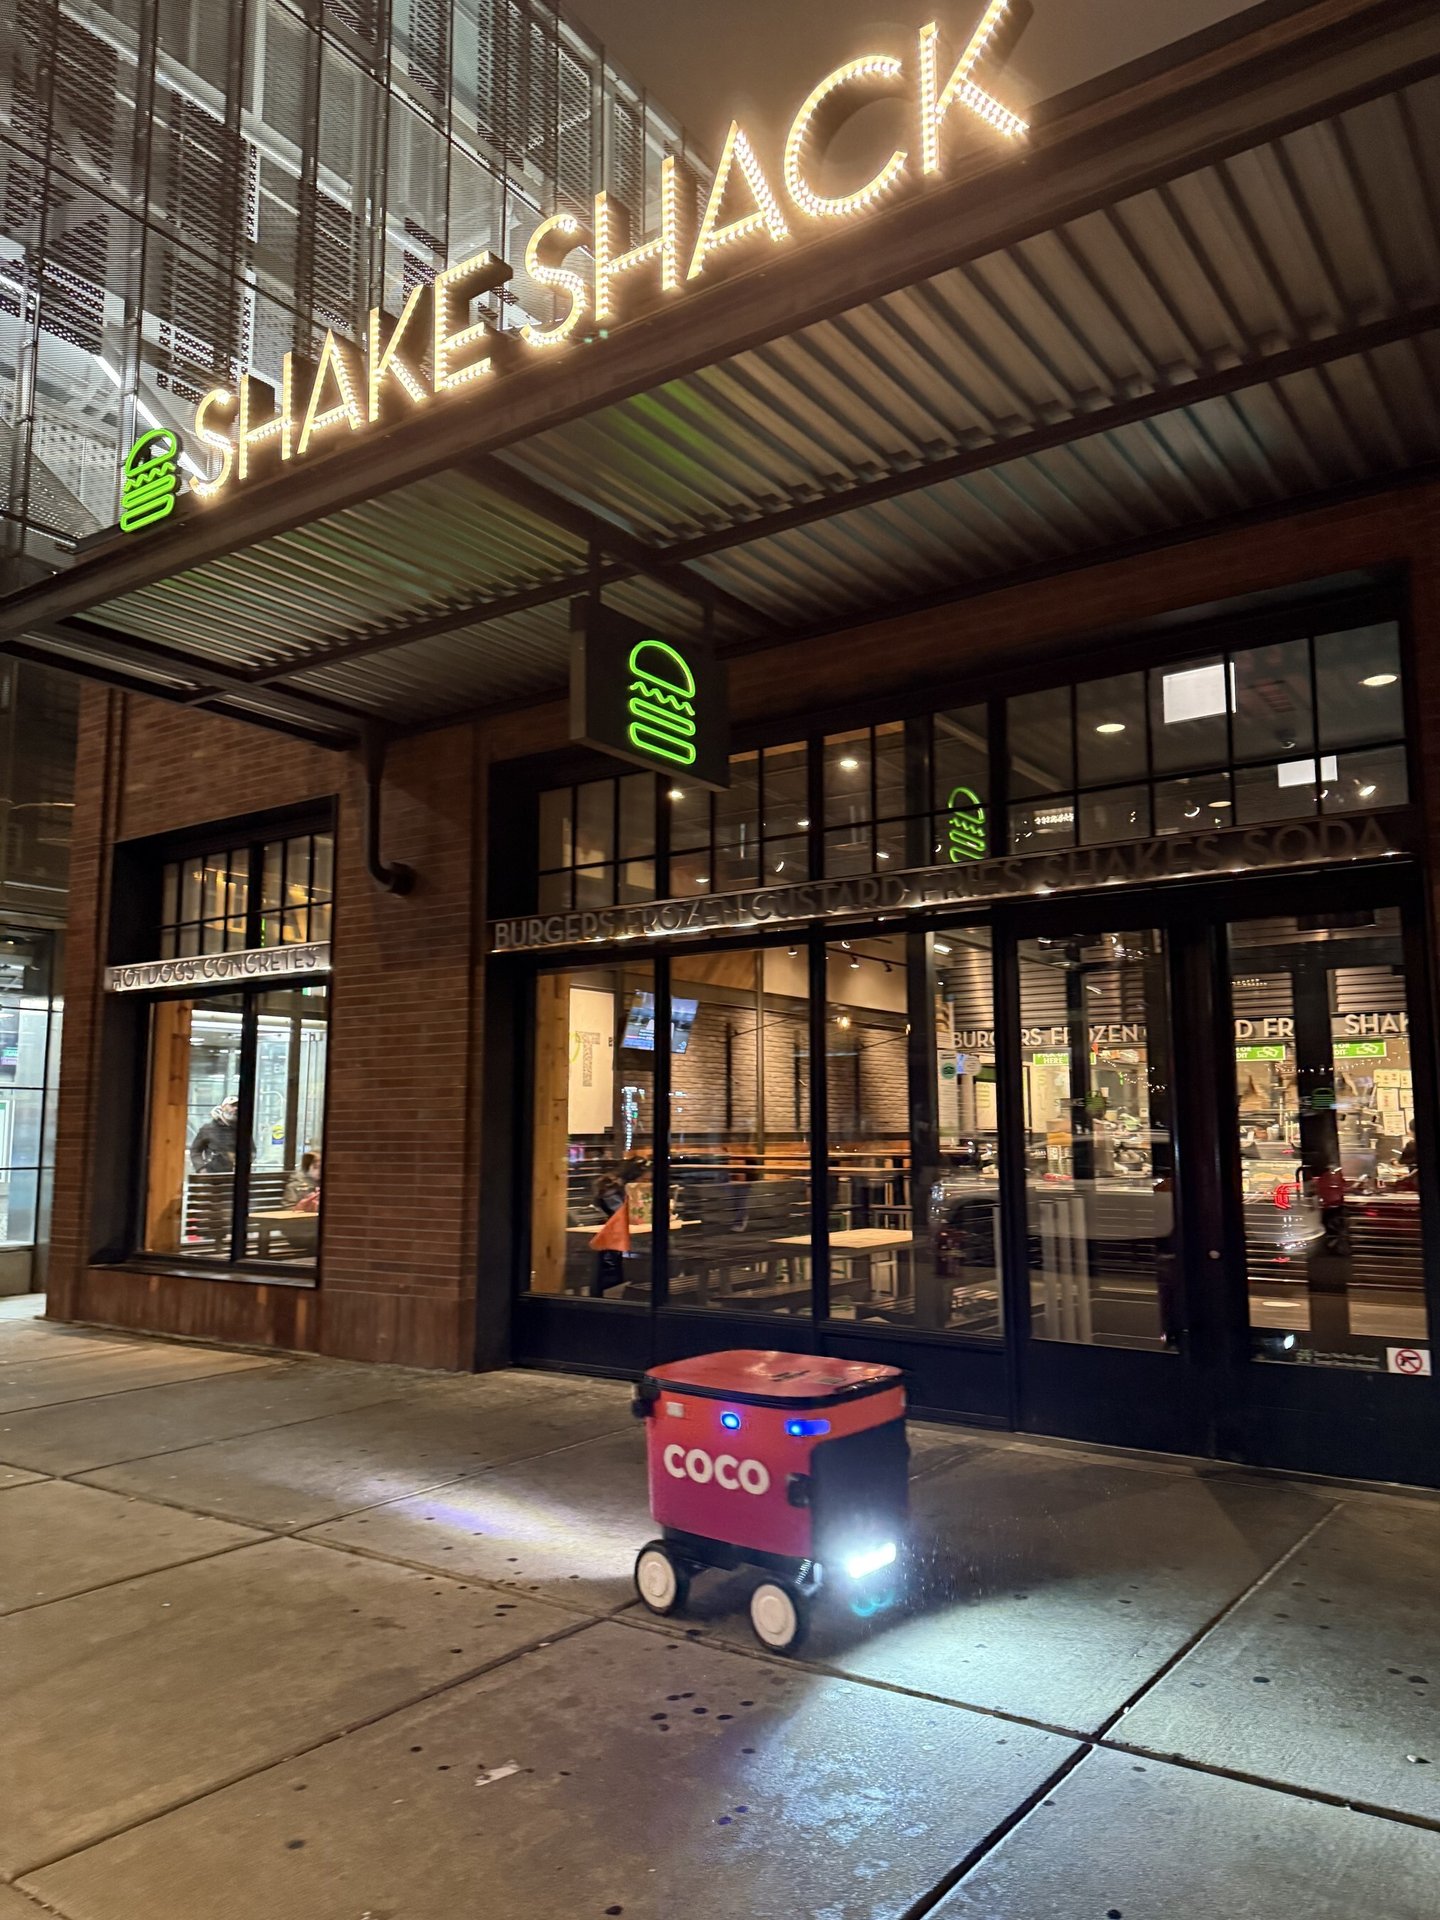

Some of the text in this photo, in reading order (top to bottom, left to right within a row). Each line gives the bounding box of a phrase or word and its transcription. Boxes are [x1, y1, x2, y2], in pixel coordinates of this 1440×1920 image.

[189, 0, 1030, 497] SHAKE SHACK
[494, 911, 615, 948] BURGERS
[624, 894, 743, 936] FROZEN
[752, 876, 907, 921] CUSTARD
[1043, 834, 1221, 888] SHAKES
[1243, 815, 1390, 866] SODA
[113, 946, 320, 989] HOT DOGS CONCRETES
